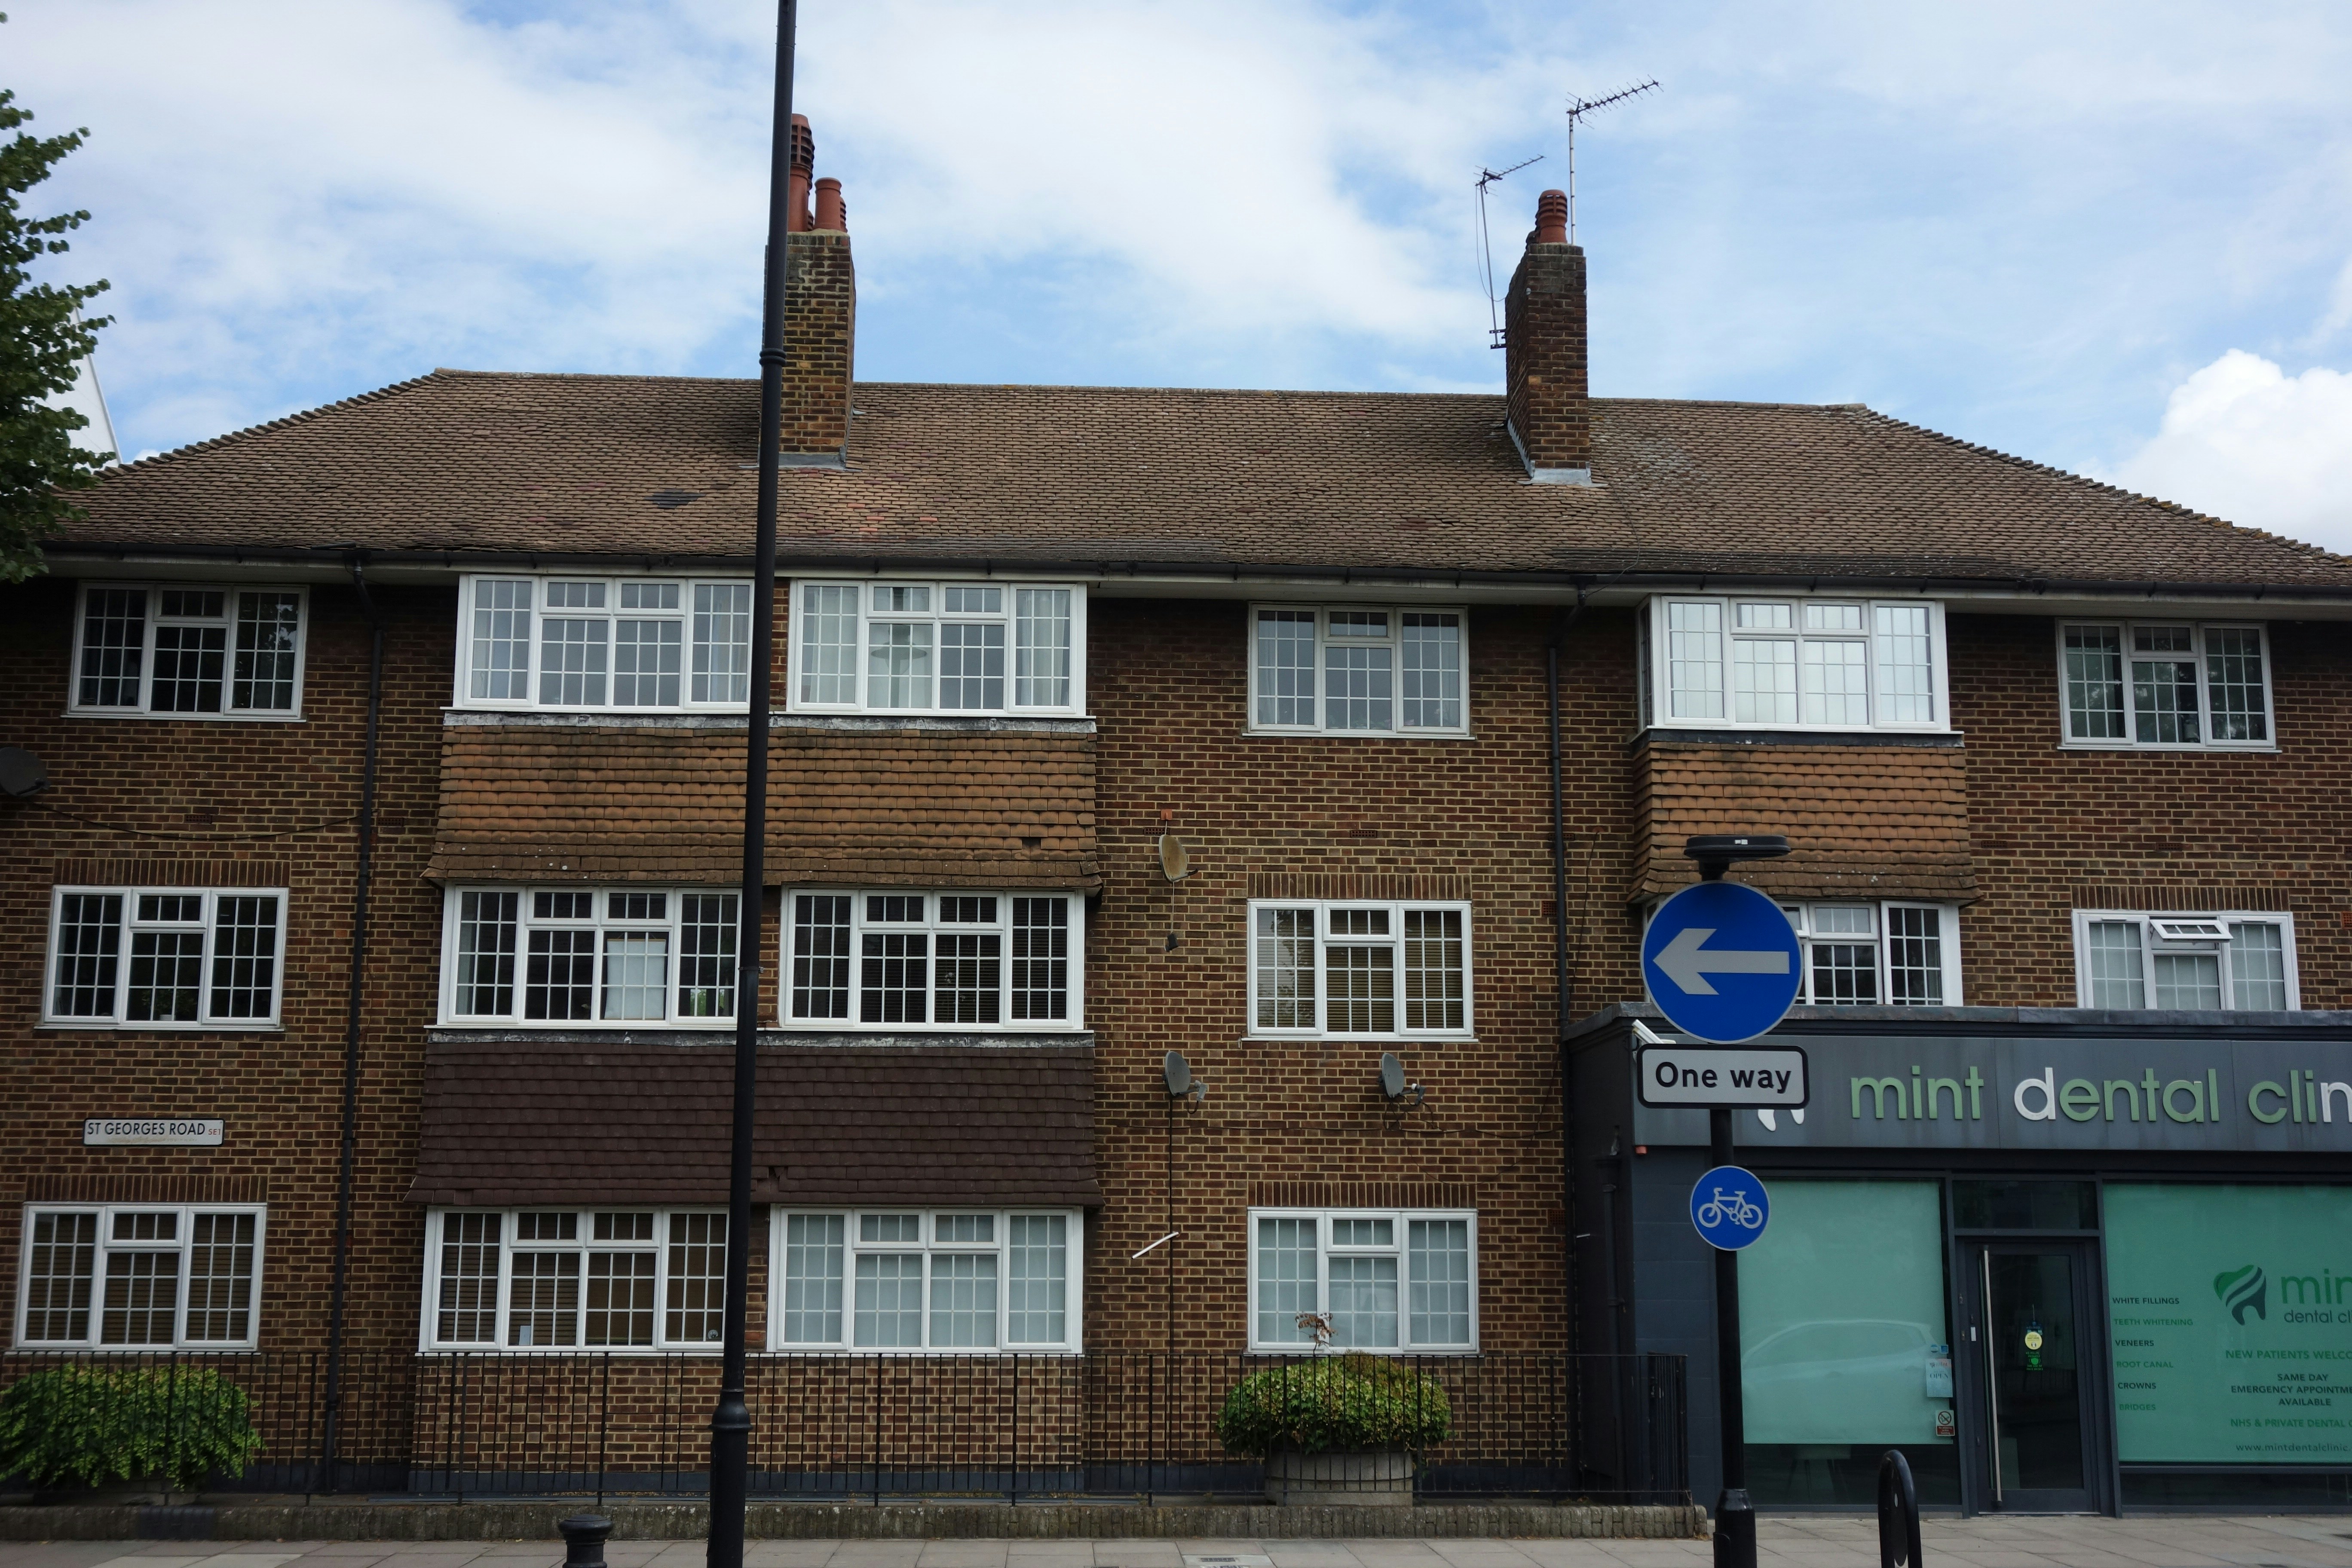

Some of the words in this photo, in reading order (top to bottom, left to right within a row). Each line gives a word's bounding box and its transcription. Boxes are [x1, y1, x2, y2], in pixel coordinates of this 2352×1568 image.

[1655, 1061, 1718, 1088] One
[1730, 1069, 1792, 1094] way
[1850, 1065, 1984, 1120] mint
[2013, 1067, 2220, 1123] dental
[87, 1122, 101, 1135] ST
[104, 1122, 165, 1135] GEORGES
[169, 1122, 206, 1136] ROAD
[2284, 1310, 2334, 1323] dental
[2225, 1350, 2253, 1359] NEW
[2257, 1350, 2309, 1360] PATIENTS
[2277, 1374, 2305, 1382] SAME
[2231, 1385, 2293, 1394] EMERGENCY
[2278, 1398, 2331, 1406] AVAILABLE
[2230, 1419, 2251, 1427] NHS
[2264, 1419, 2304, 1427] PRIVATE
[2307, 1419, 2345, 1427] DENTAL
[2236, 1442, 2352, 1452] www.mintdentalclinic.
